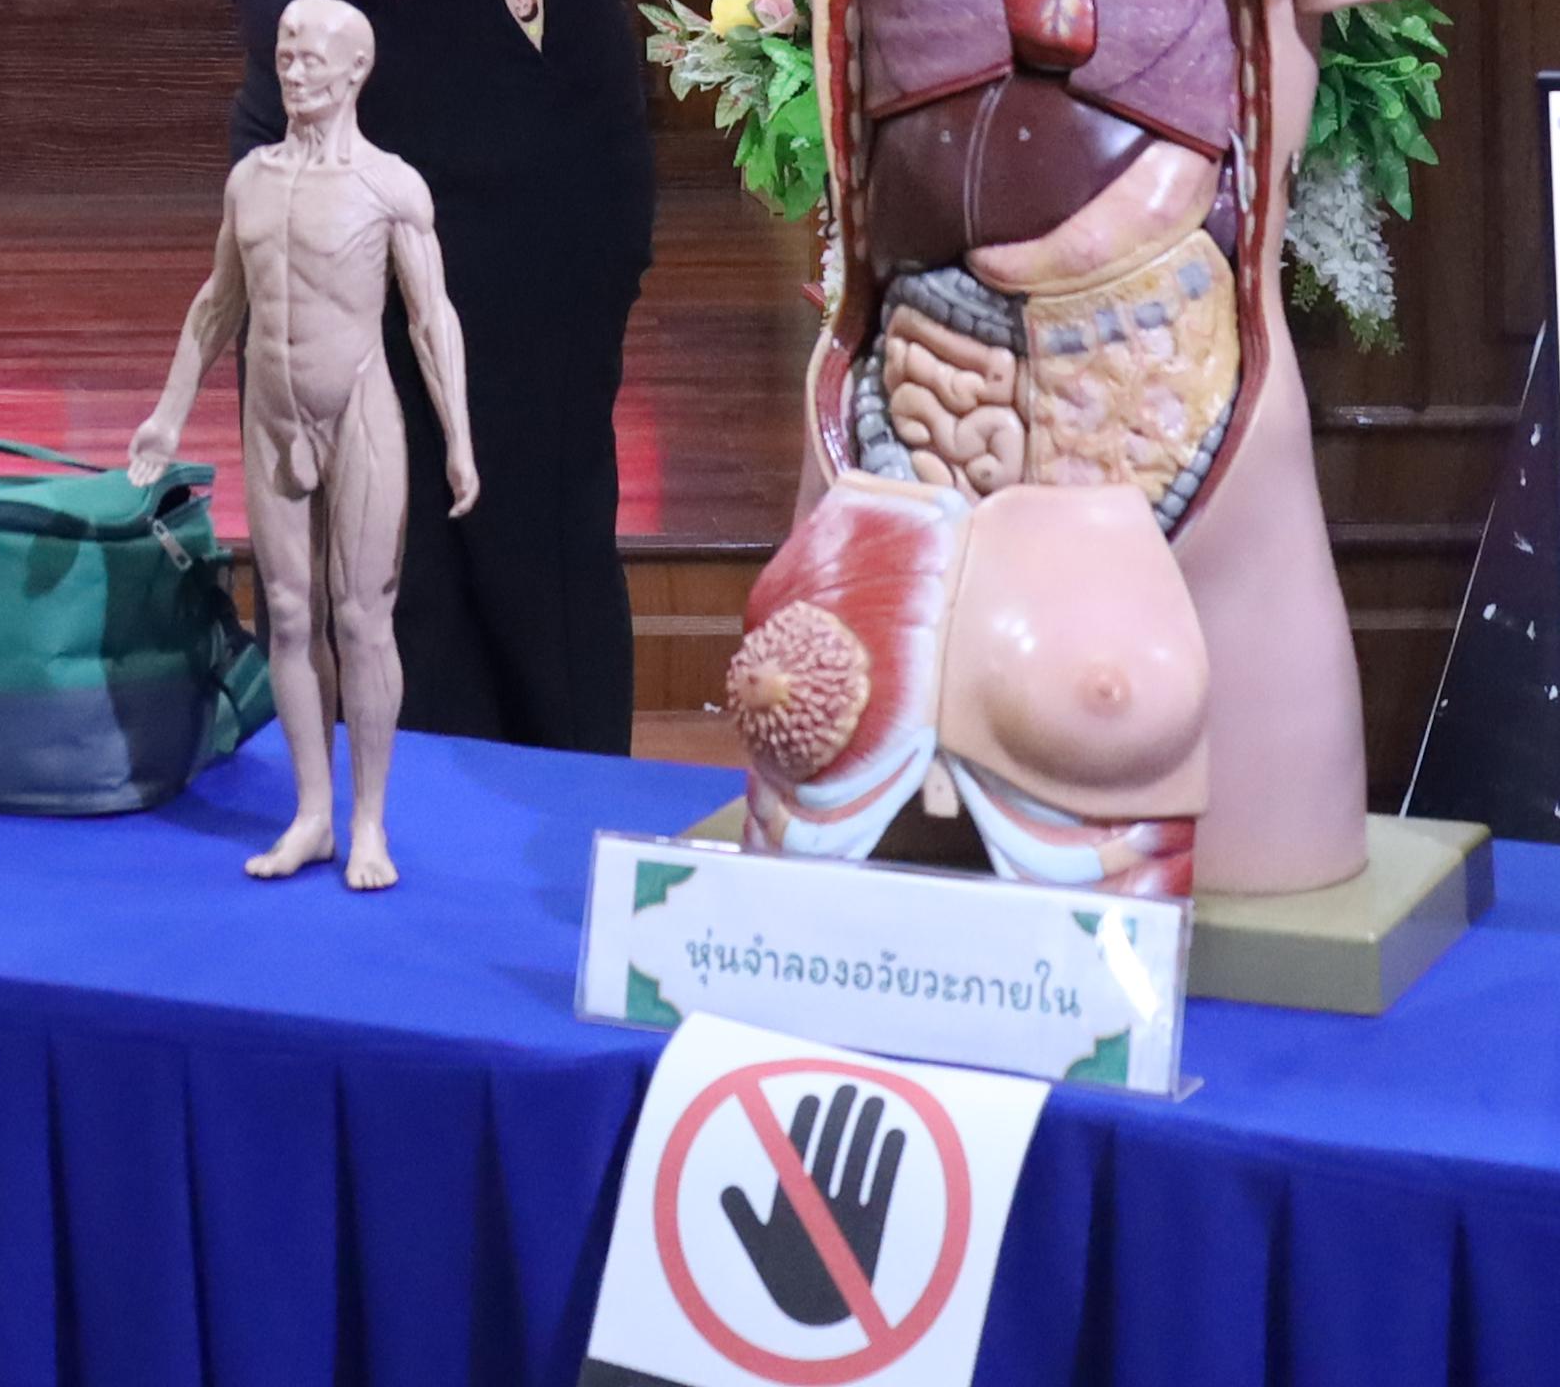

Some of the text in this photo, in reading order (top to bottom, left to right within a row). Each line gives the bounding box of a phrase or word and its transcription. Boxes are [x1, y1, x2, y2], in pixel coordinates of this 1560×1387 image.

[685, 927, 1081, 1018] หุ่นจำลองอวัยวะภายใน
